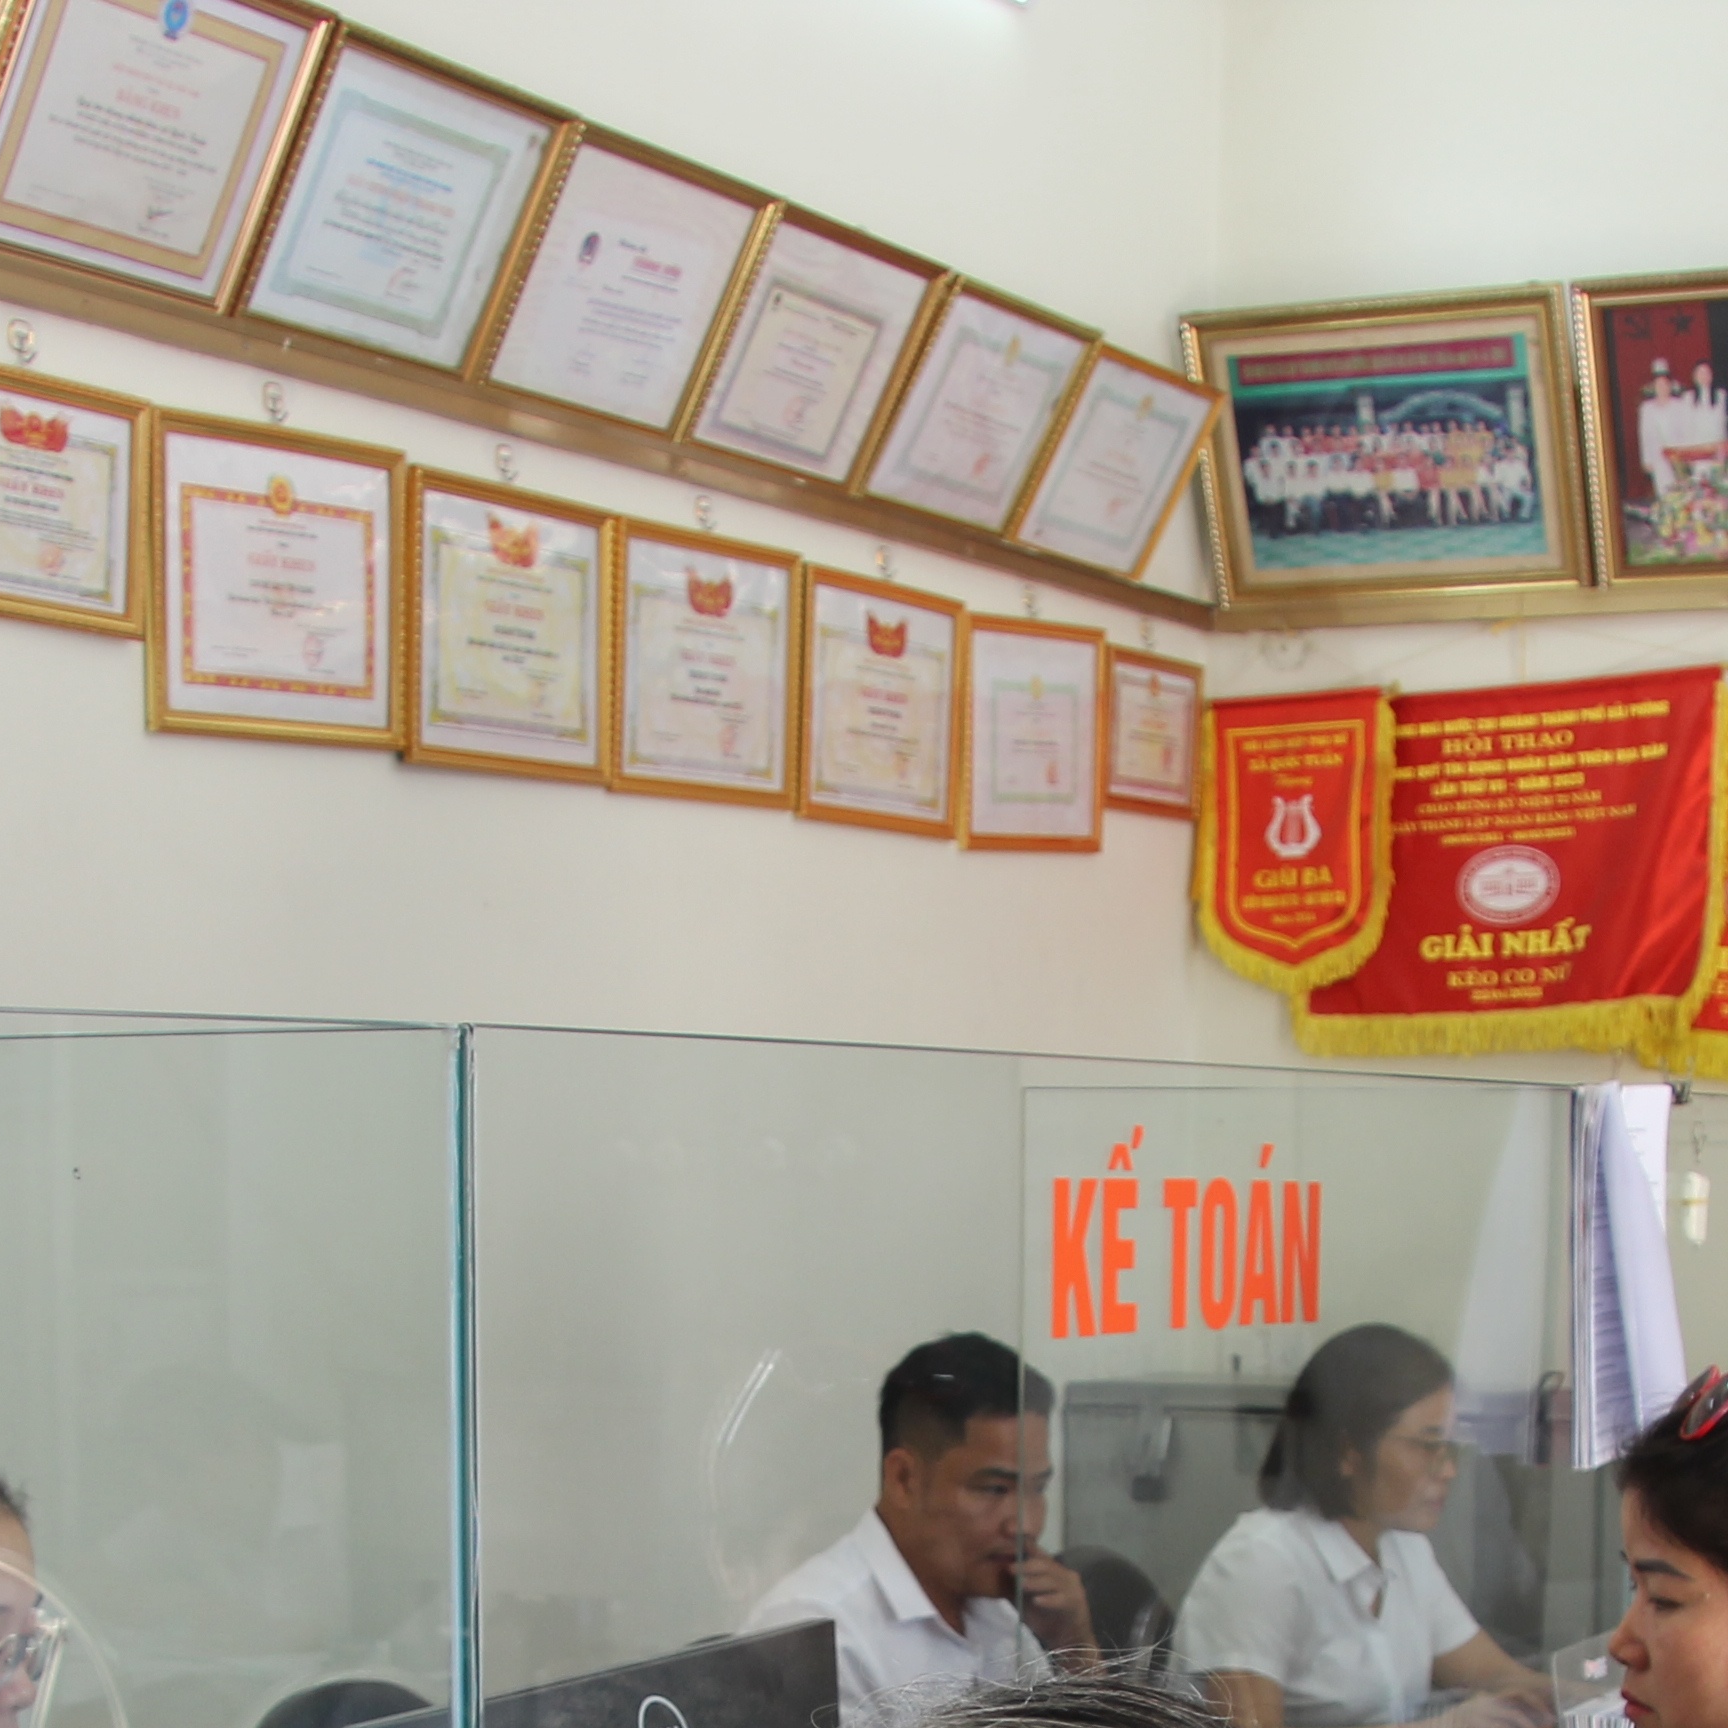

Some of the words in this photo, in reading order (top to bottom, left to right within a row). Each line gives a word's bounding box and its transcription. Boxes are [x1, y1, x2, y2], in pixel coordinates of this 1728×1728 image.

[1418, 922, 1495, 963] GIẢI
[1500, 915, 1593, 958] NHẤT
[1051, 1124, 1144, 1339] KẾ
[1162, 1143, 1322, 1331] TOÁN
